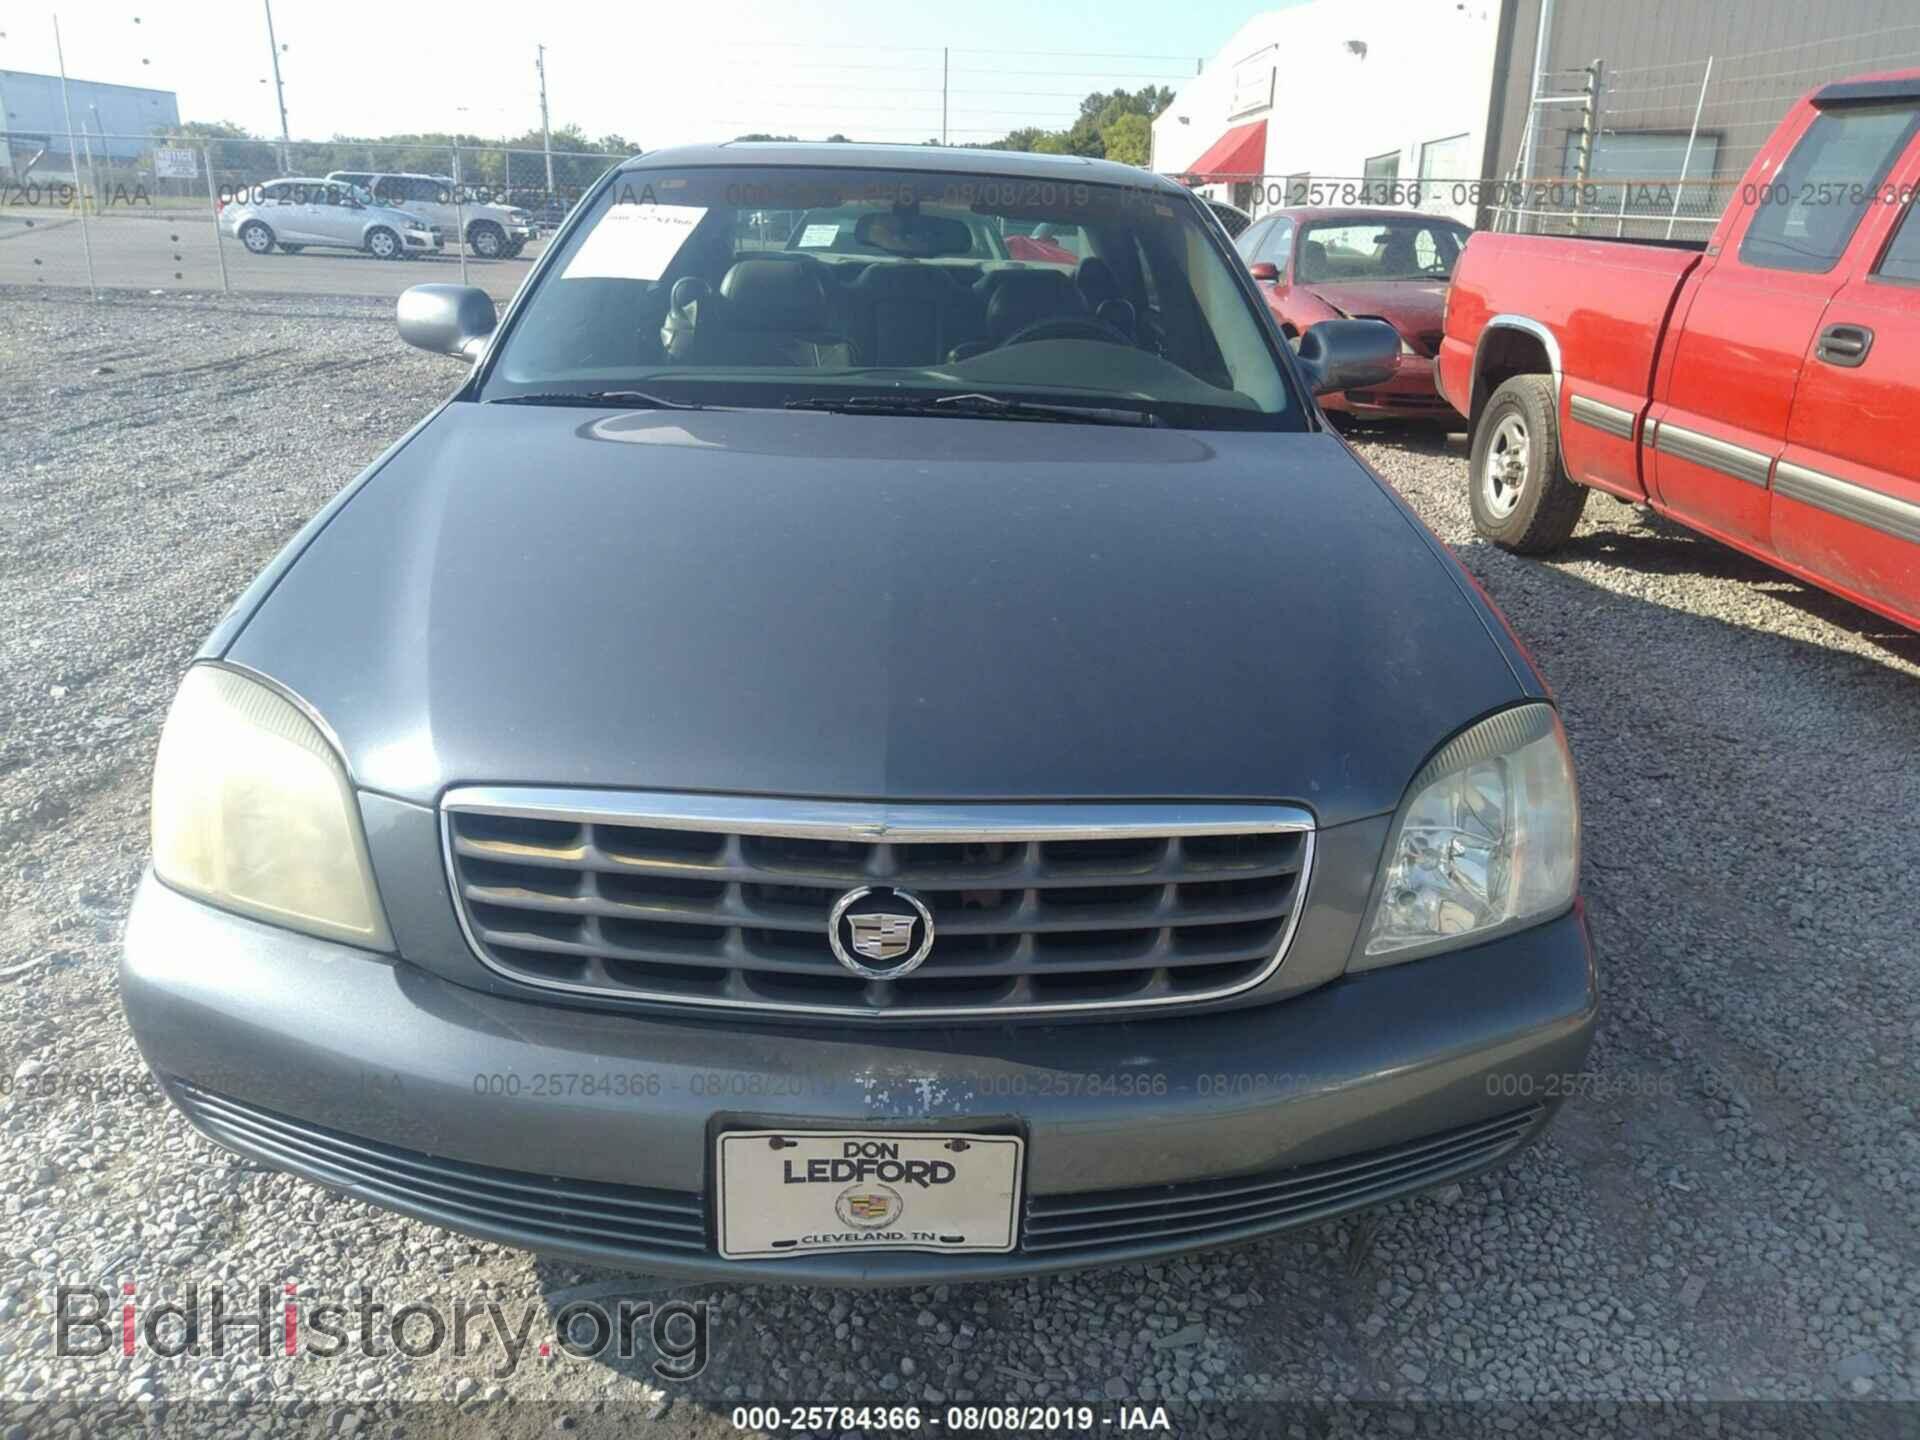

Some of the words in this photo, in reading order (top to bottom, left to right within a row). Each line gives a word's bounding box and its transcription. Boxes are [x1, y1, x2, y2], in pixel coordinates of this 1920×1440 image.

[843, 1141, 899, 1159] DON
[783, 1158, 956, 1188] LEDFORD
[911, 1231, 936, 1241] TN
